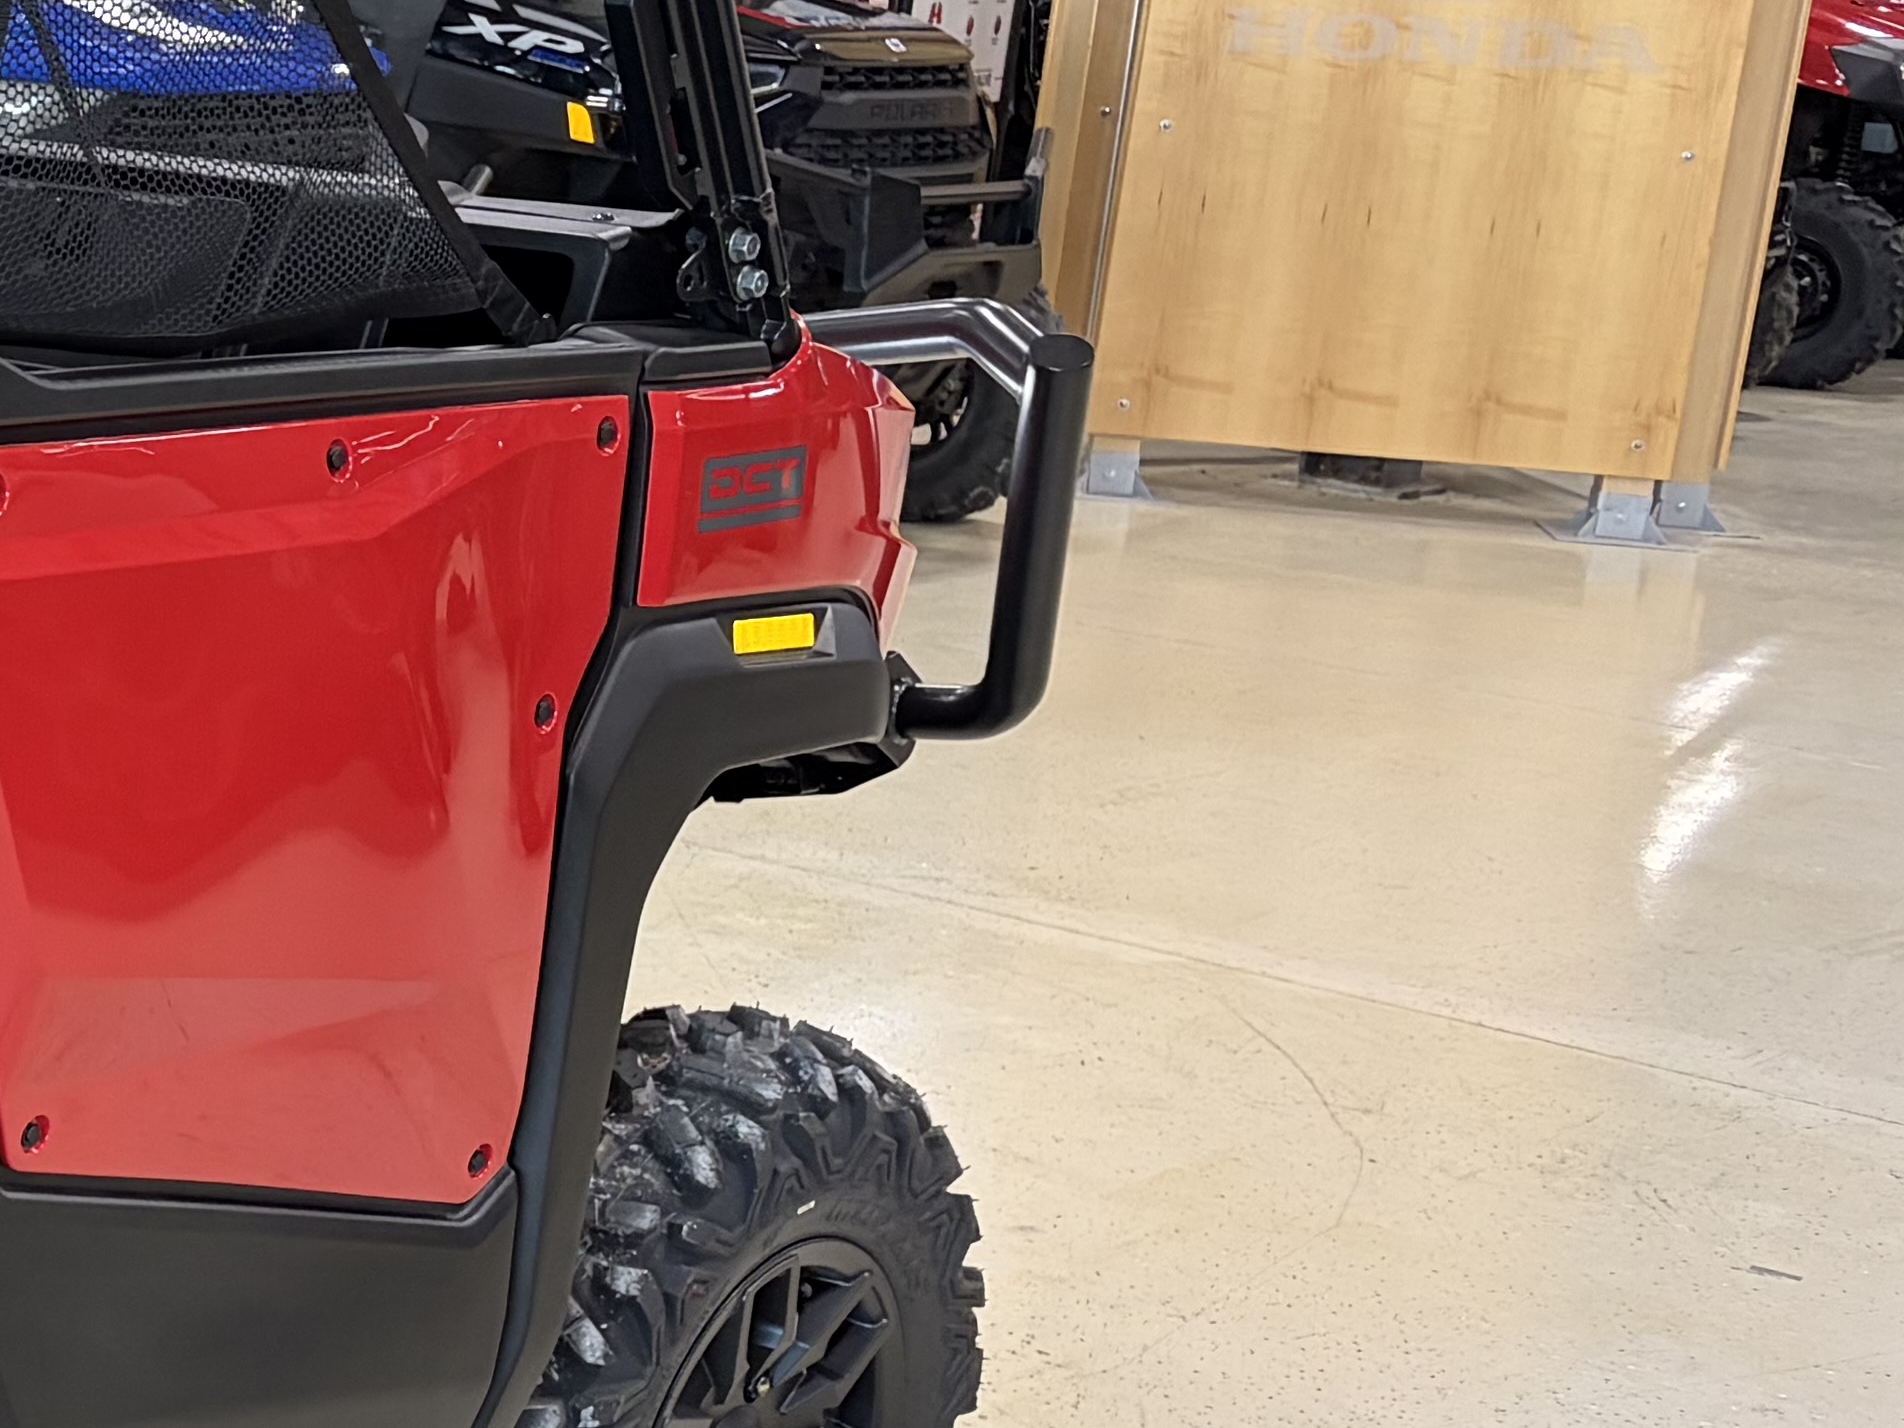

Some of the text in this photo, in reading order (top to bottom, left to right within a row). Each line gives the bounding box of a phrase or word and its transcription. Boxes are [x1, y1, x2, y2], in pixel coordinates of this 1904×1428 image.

[442, 12, 585, 54] XP
[1224, 6, 1664, 78] HONDA
[869, 102, 964, 124] POLAR
[708, 457, 800, 500] DCT
